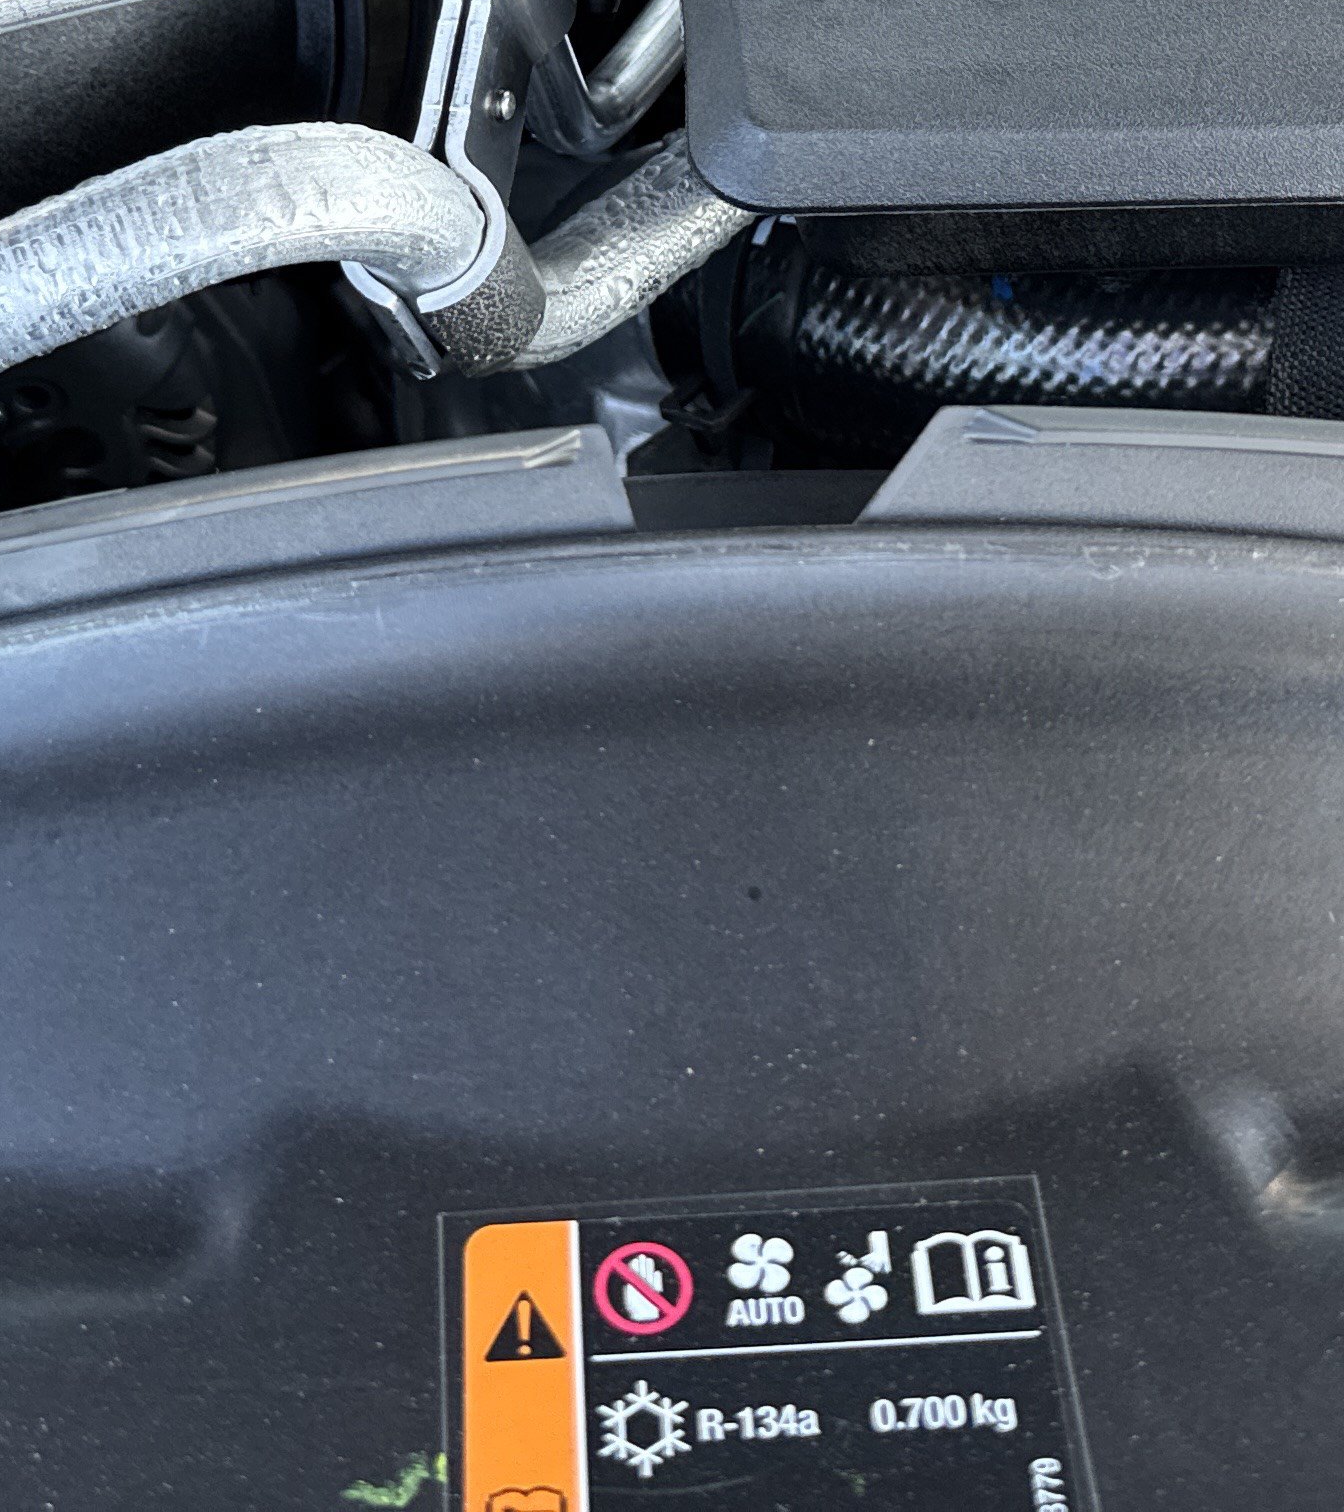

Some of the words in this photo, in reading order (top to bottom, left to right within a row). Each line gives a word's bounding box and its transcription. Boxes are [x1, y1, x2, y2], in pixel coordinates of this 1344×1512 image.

[726, 1295, 806, 1327] AUTO
[696, 1404, 821, 1441] R-134a
[869, 1395, 967, 1433] 0.700
[970, 1392, 1018, 1433] kg
